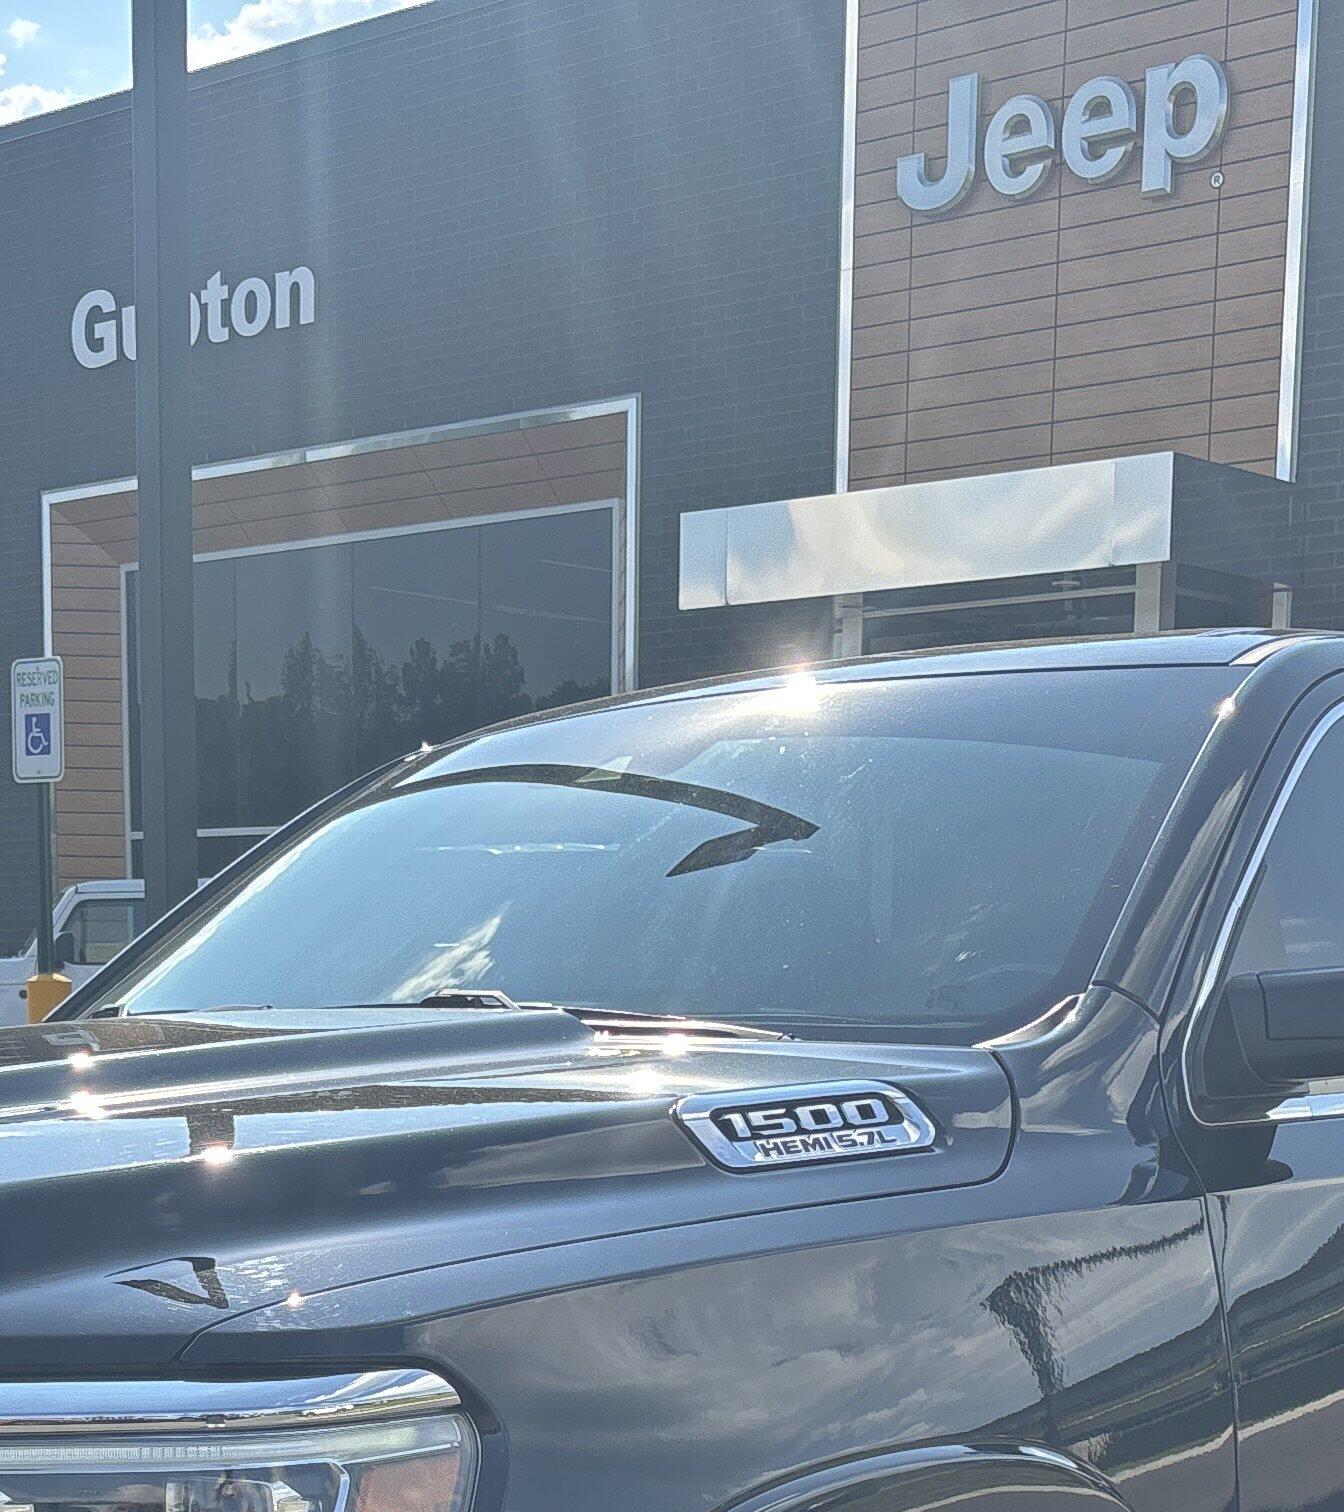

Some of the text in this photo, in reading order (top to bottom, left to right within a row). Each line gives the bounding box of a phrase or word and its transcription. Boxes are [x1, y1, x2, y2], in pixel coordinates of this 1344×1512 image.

[896, 53, 1231, 217] Jeep
[71, 266, 315, 369] Gton
[16, 669, 59, 687] RESERVED
[19, 690, 56, 708] PARKING
[720, 1098, 890, 1138] 1500
[759, 1129, 897, 1158] HEMI 5.7L
